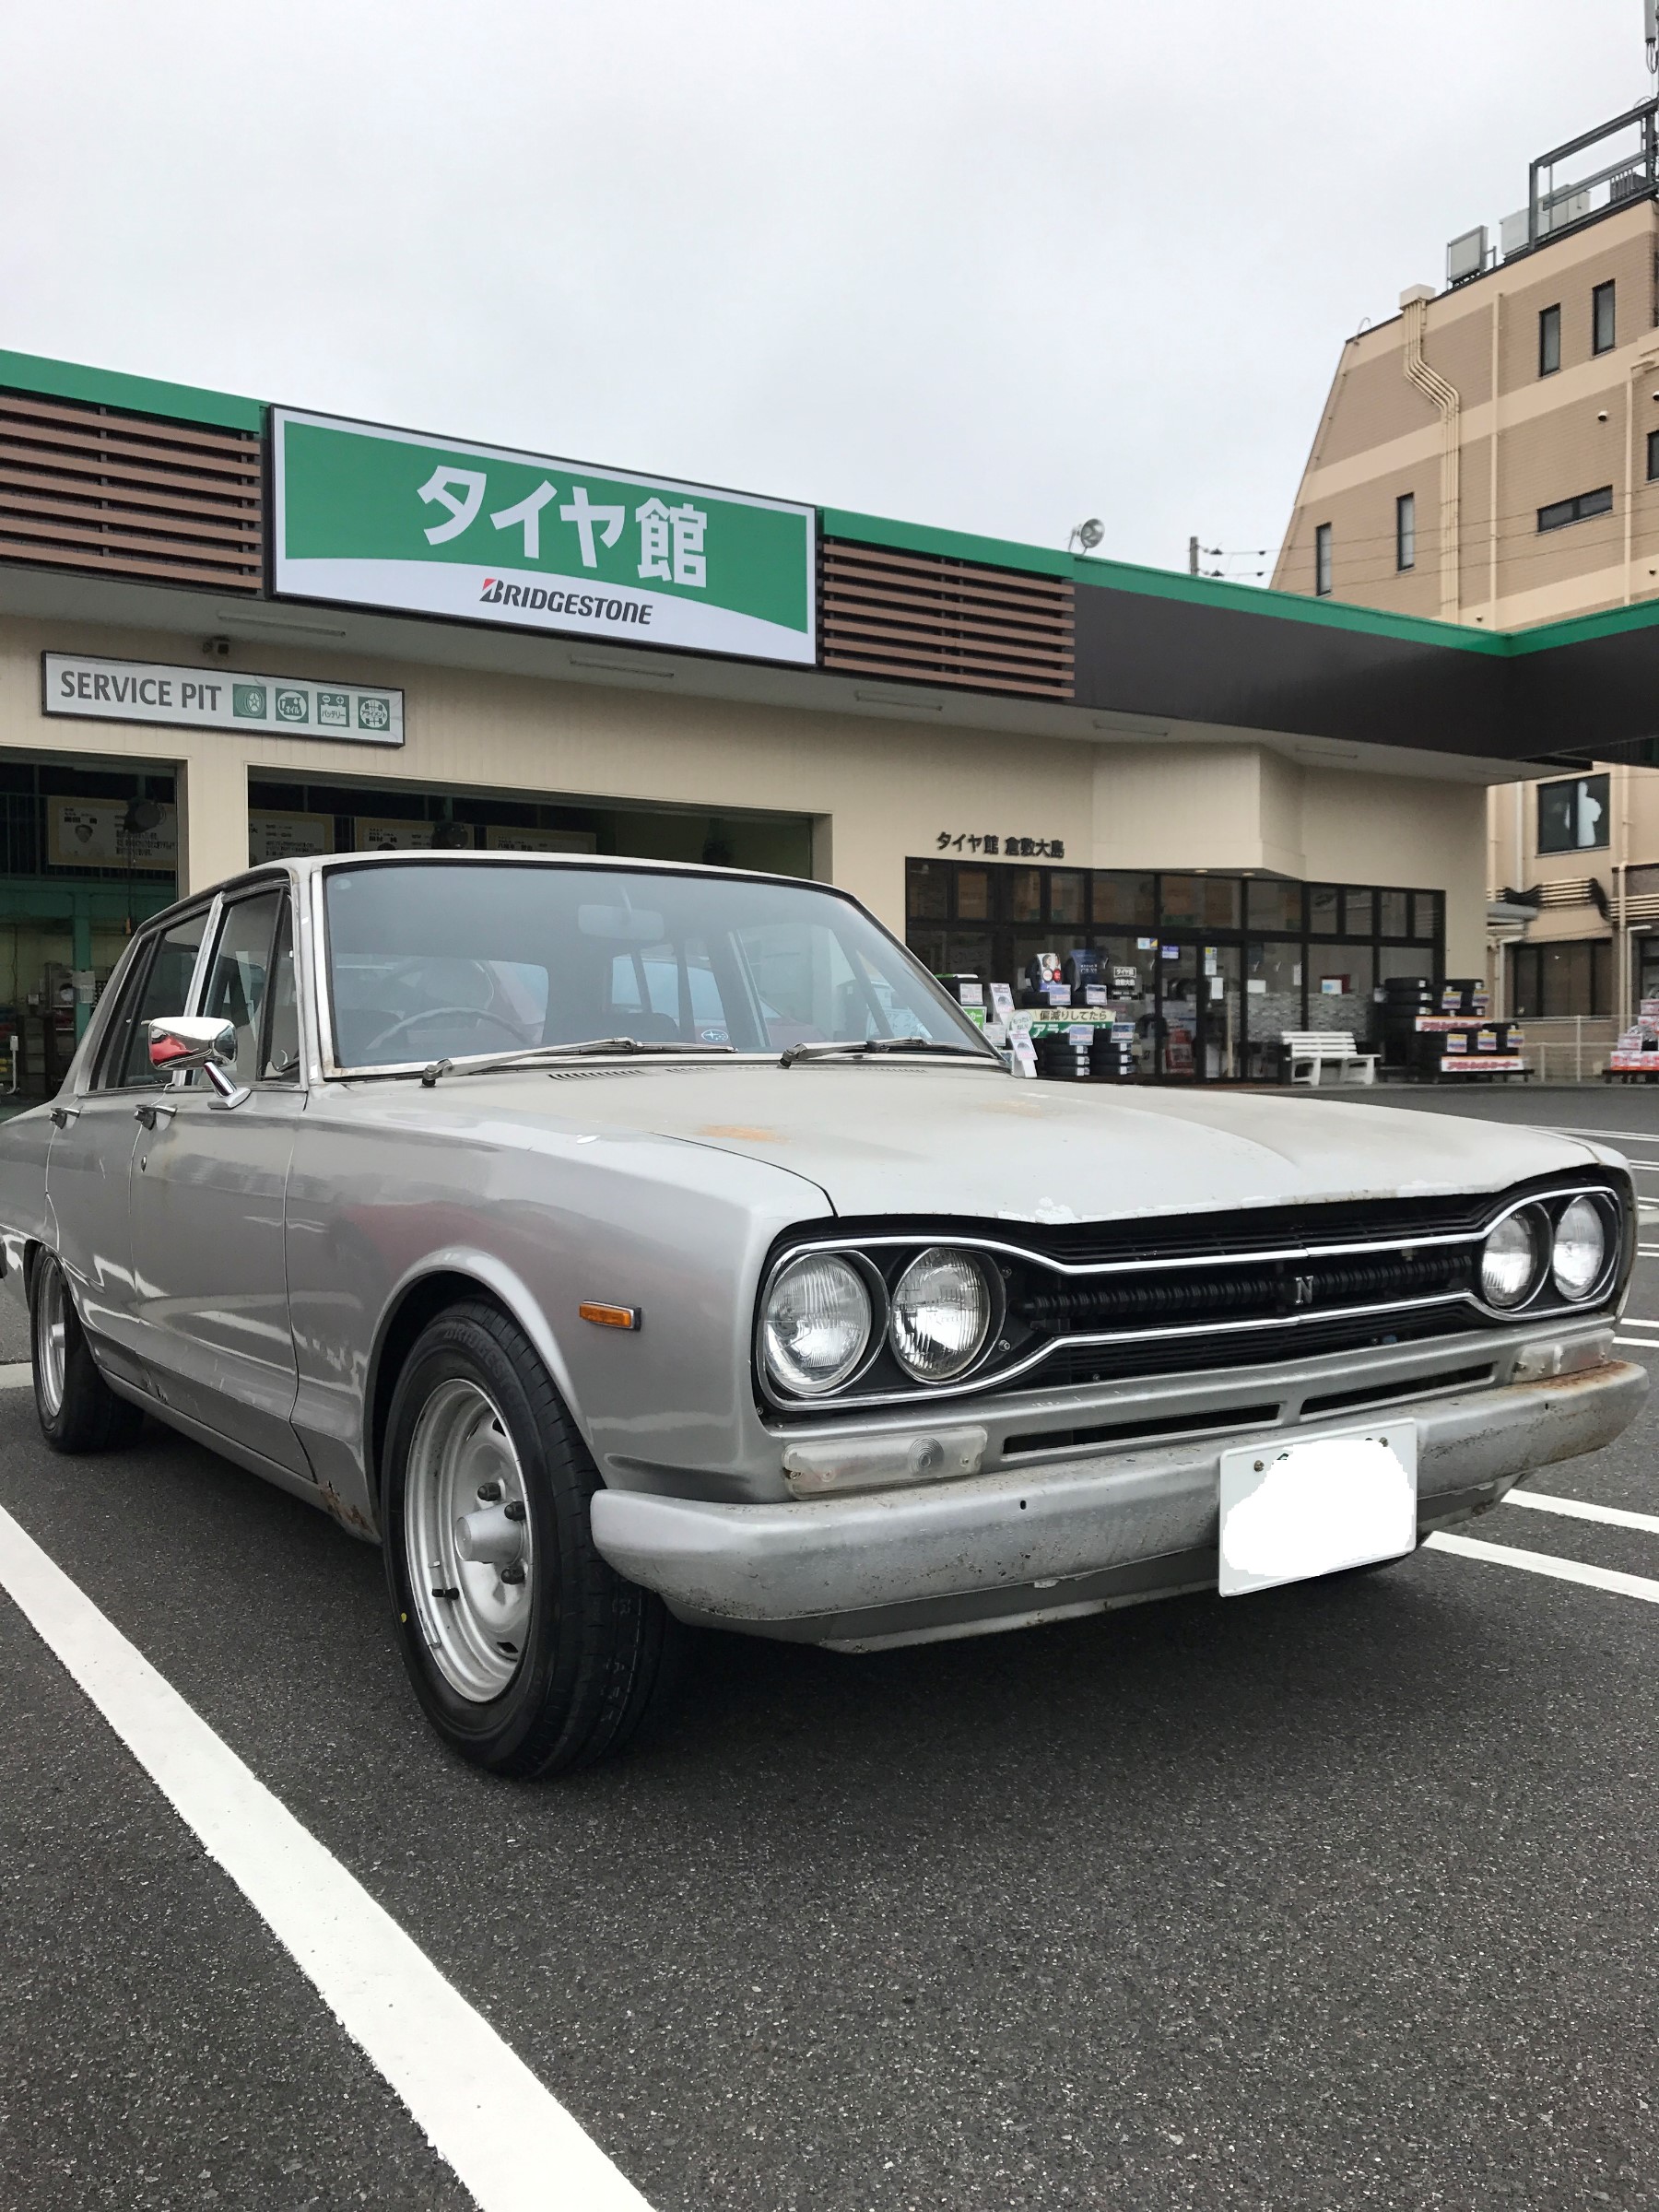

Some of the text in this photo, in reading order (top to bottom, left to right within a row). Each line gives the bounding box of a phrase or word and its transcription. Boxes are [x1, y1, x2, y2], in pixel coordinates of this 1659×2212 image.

[417, 465, 707, 588] タイヤ館
[479, 578, 653, 625] BRIDGESTONE
[60, 670, 222, 712] SERVICE PIT
[285, 706, 300, 714] オイル
[322, 710, 346, 719] バッテリー
[360, 710, 387, 718] アライメント
[936, 831, 1065, 859] タイヤ館 倉敷大島
[1039, 1009, 1107, 1021] 偏減りしてたら
